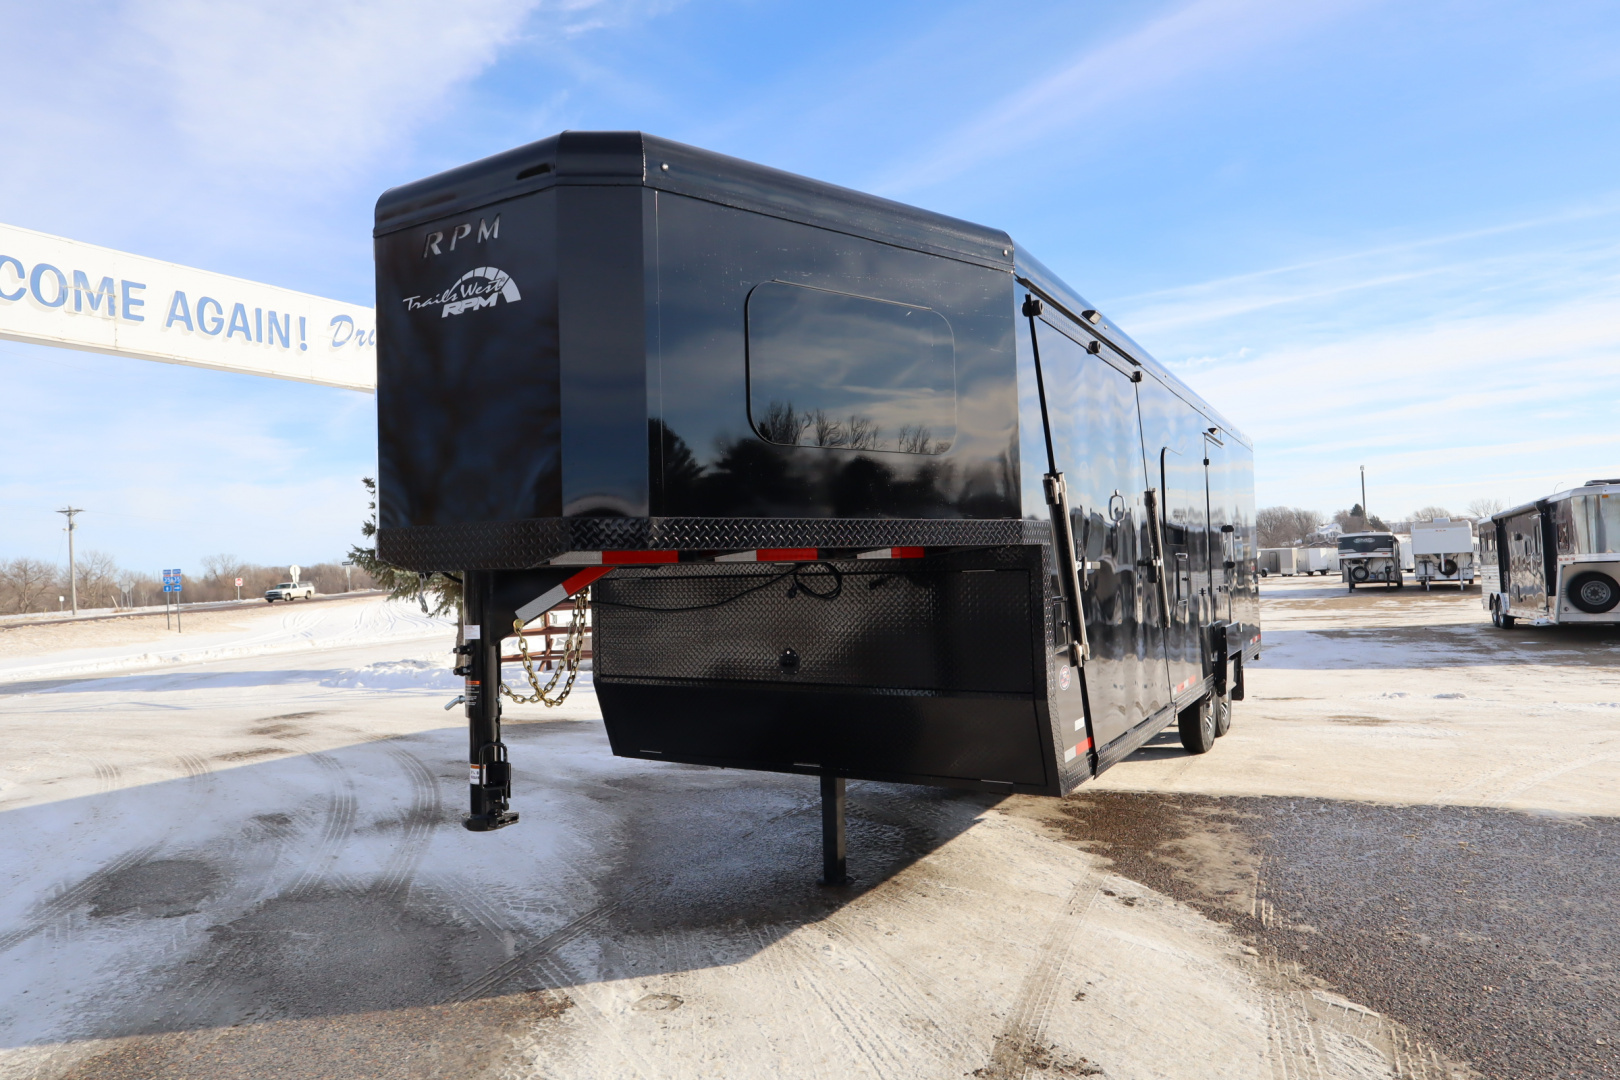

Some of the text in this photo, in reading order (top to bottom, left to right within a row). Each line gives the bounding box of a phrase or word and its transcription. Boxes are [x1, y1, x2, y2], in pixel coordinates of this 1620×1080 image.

[422, 213, 500, 259] RPM
[0, 255, 147, 322] COME
[165, 290, 308, 351] AGAIN!
[402, 277, 504, 311] Trails West
[441, 292, 500, 318] RPM
